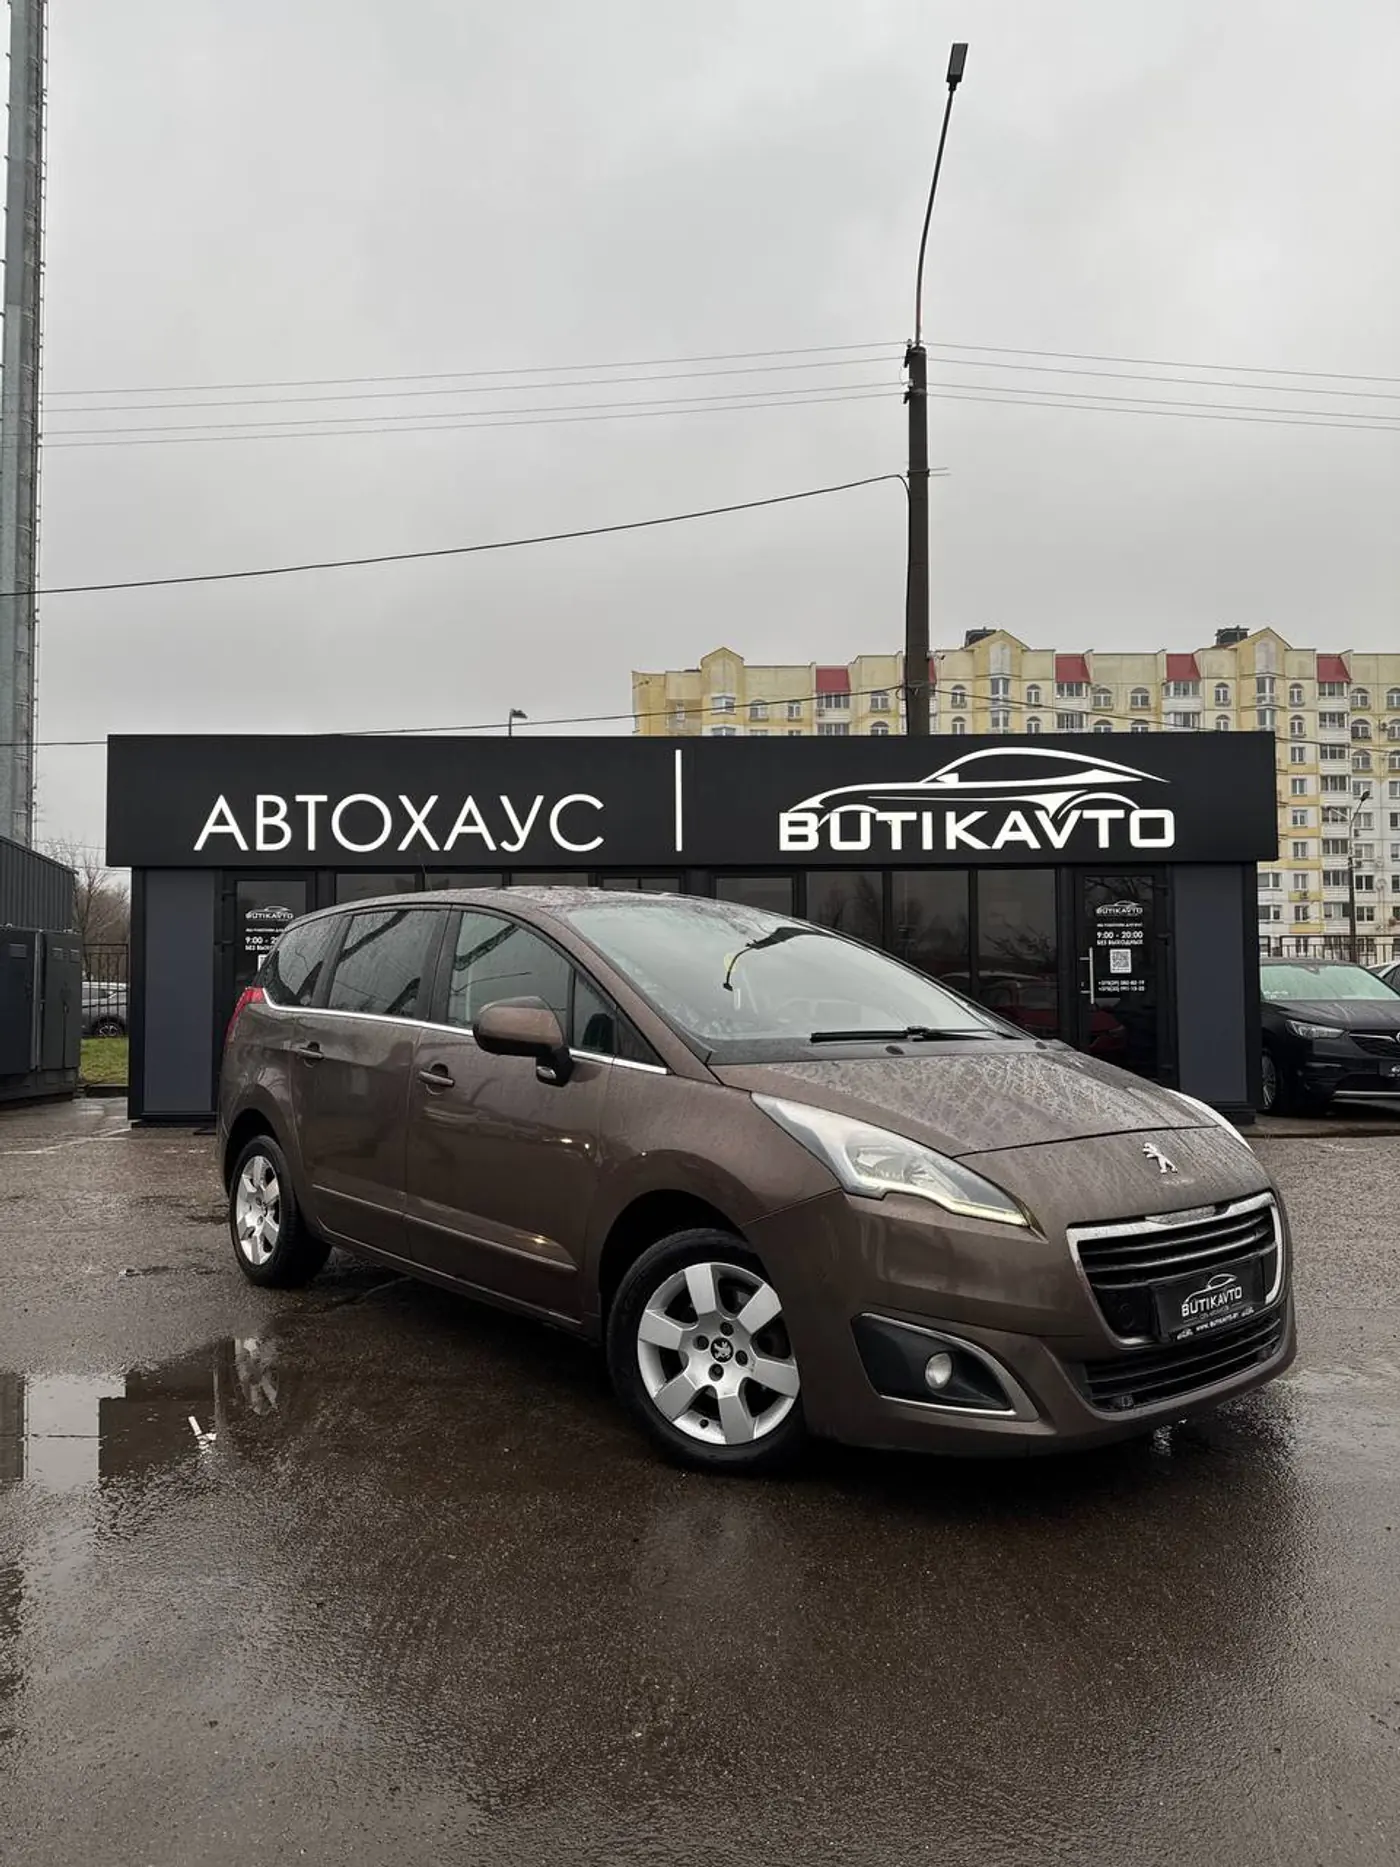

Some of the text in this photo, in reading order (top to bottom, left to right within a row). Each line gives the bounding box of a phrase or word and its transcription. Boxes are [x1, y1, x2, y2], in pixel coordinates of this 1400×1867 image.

[193, 793, 604, 853] АВТОХАУС
[779, 809, 1175, 852] BUTIKAVTO
[245, 936, 264, 944] 9:00
[1096, 931, 1114, 939] 9:00
[1120, 930, 1144, 939] 20:00
[1181, 1286, 1243, 1317] BUTIKAVTO
